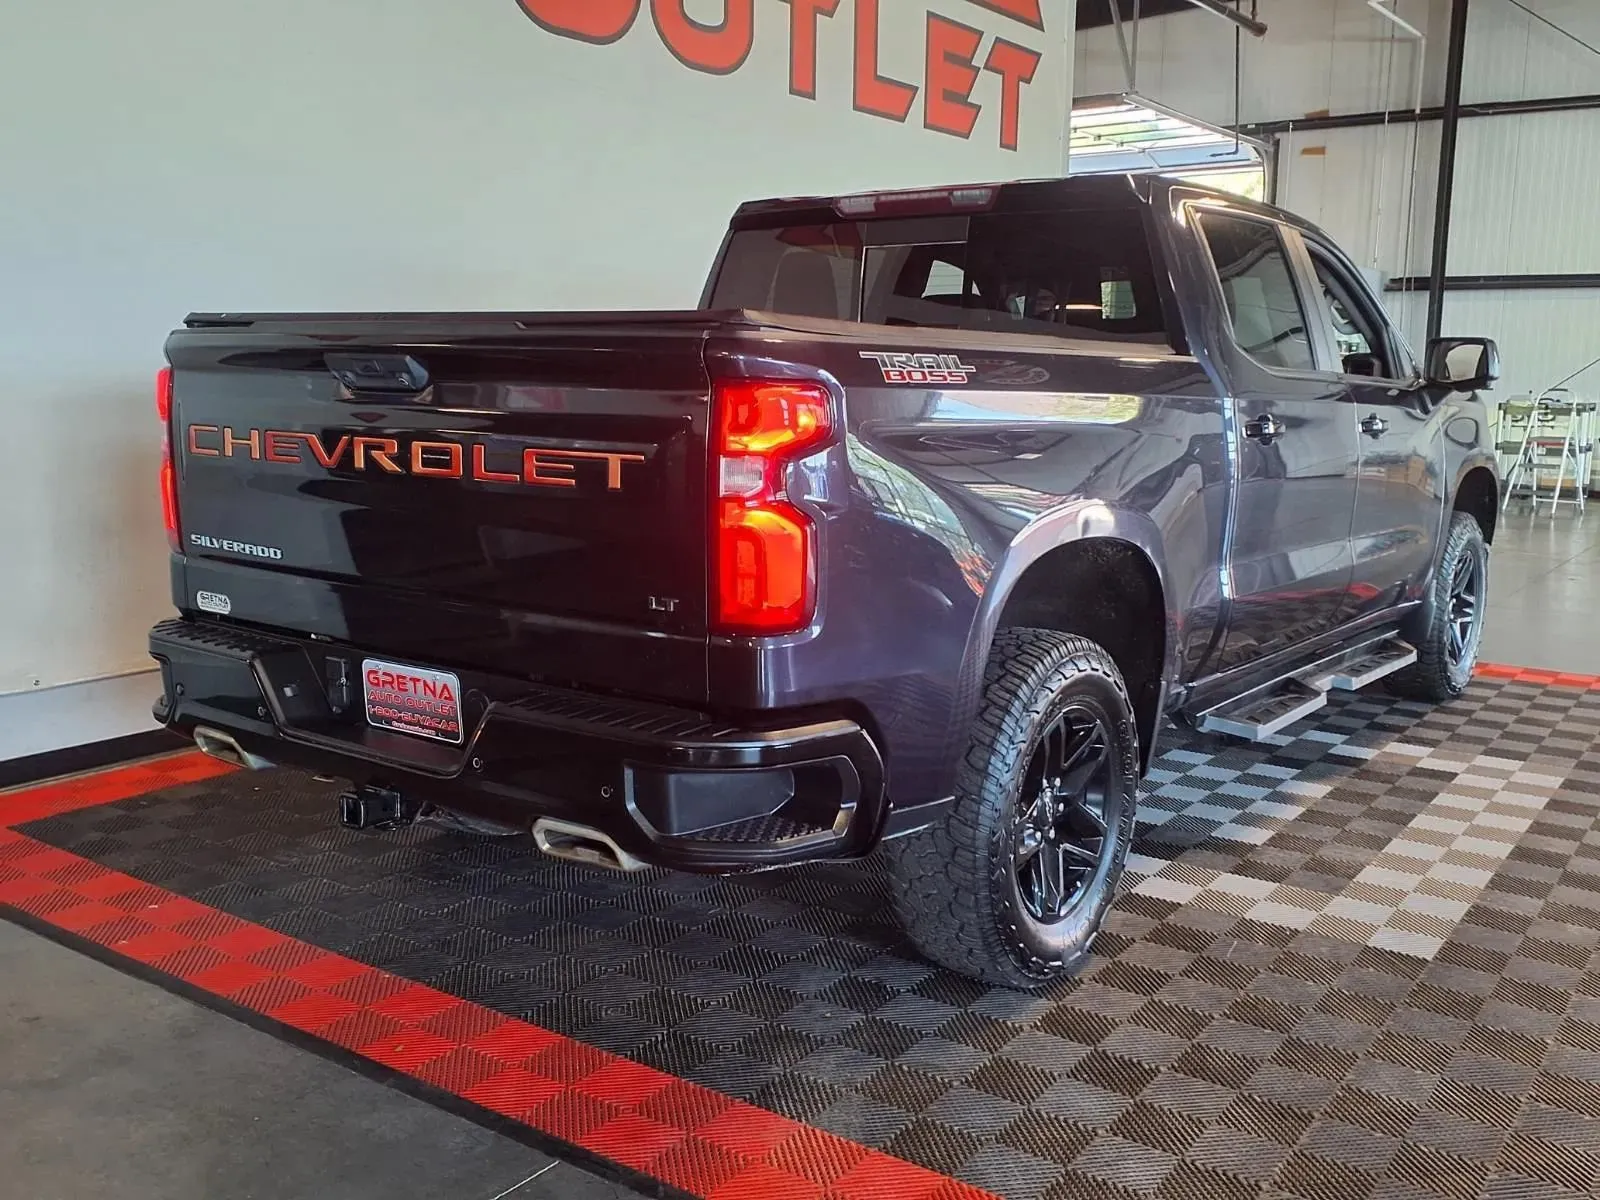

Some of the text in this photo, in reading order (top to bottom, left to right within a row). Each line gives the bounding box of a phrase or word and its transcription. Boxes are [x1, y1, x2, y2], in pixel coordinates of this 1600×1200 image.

[859, 351, 976, 372] TRAIL
[883, 369, 968, 383] BOSS
[187, 425, 645, 490] CHEVROLET
[190, 533, 282, 559] SILVERADO
[648, 596, 680, 612] LT
[367, 670, 454, 701] GRETNA
[367, 689, 456, 716] AUTO OUTLET
